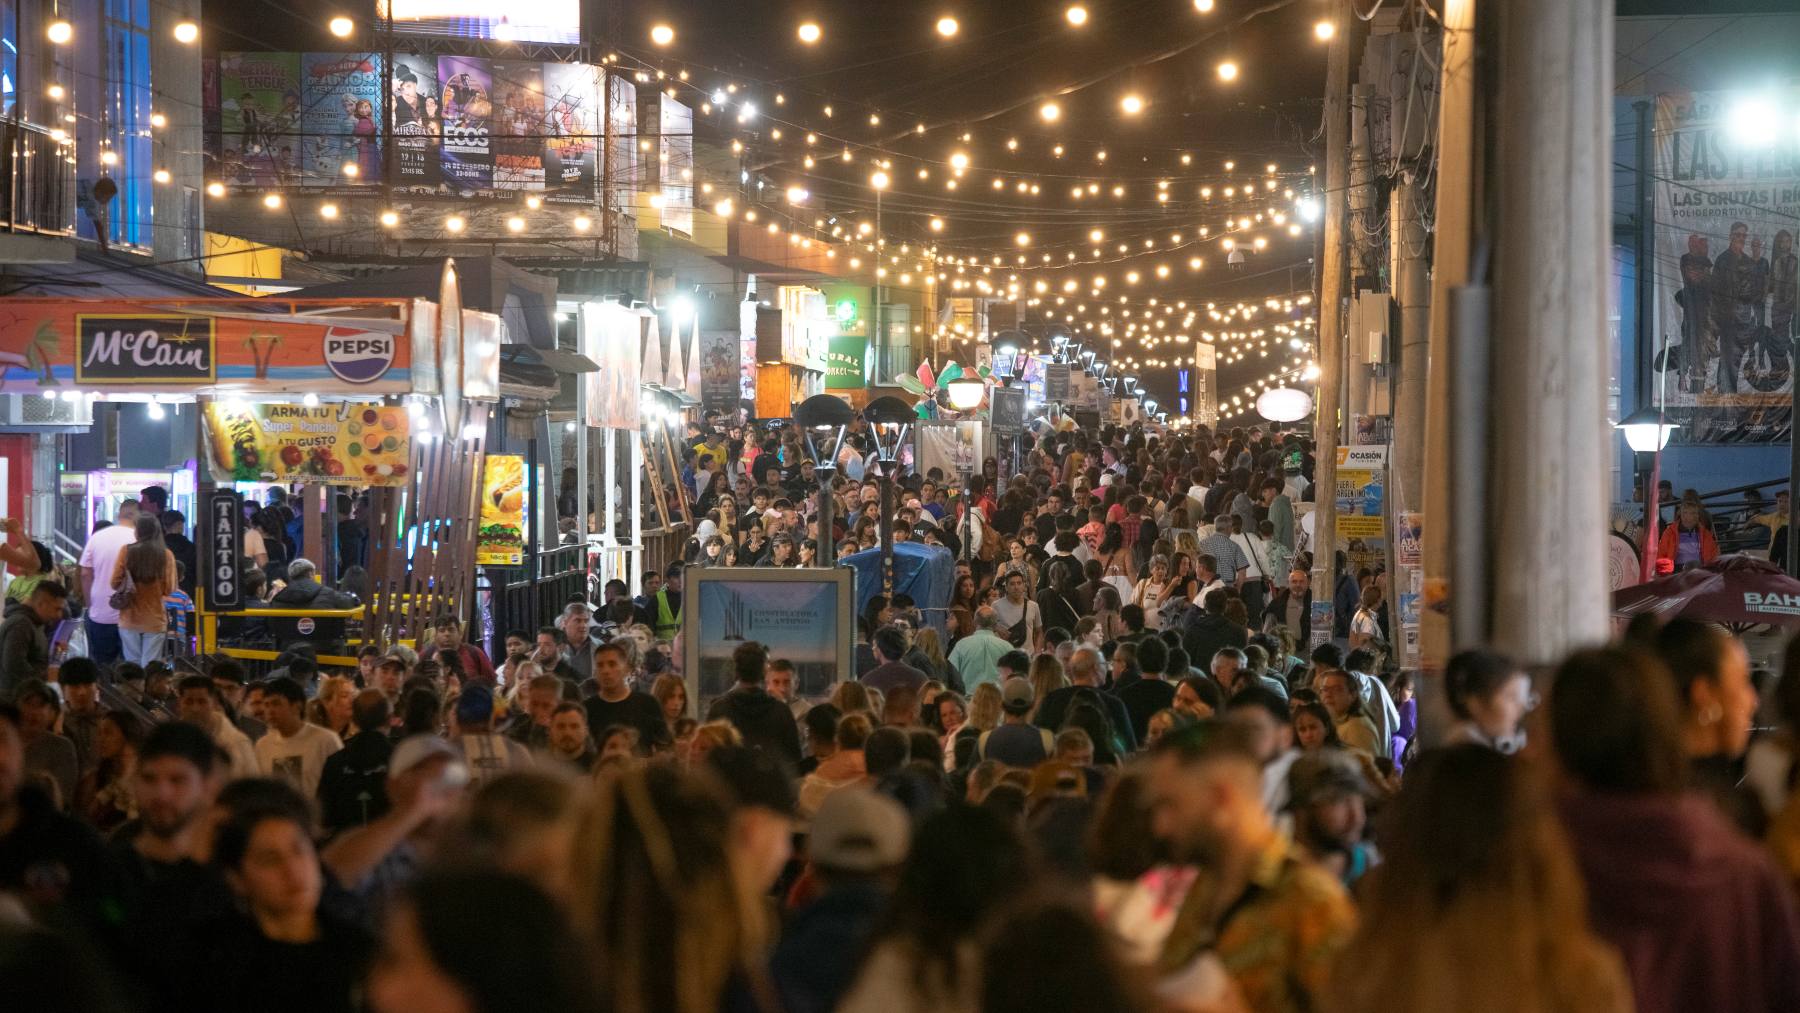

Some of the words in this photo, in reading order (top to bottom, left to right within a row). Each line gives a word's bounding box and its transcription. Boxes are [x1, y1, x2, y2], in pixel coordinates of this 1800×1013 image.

[444, 126, 489, 146] ECOS
[1673, 130, 1729, 180] LAS
[1673, 193, 1702, 206] LAS
[1707, 190, 1768, 206] GRUTAS
[1673, 207, 1752, 217] POLIDEPORTIVO
[84, 330, 209, 371] McCain
[329, 340, 390, 355] PEPSI
[271, 407, 309, 418] ARMA
[311, 408, 329, 418] TU
[263, 419, 294, 433] Super
[300, 419, 338, 433] Pancho
[297, 436, 337, 447] GUSTO
[1350, 451, 1382, 460] OCASIÓN
[216, 502, 233, 596] TATTOO
